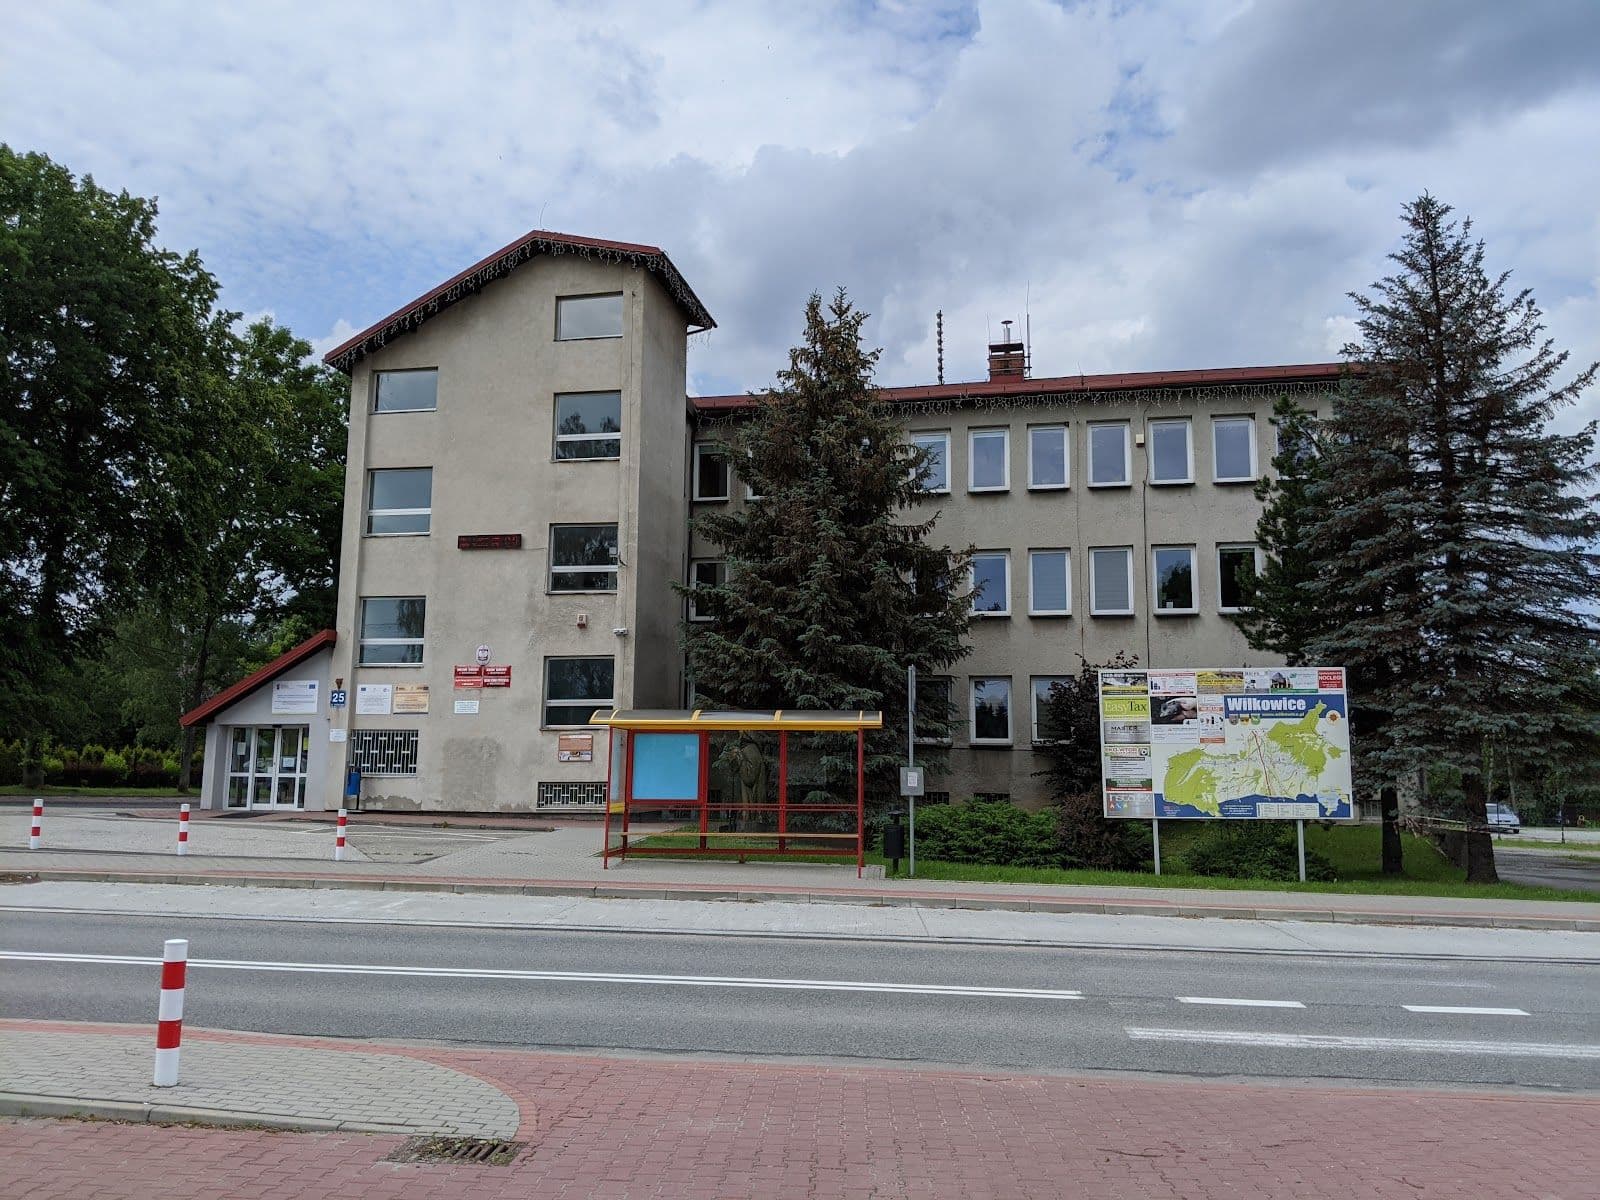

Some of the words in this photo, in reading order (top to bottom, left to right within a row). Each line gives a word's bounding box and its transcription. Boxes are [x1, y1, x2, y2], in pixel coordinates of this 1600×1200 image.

[332, 692, 344, 703] 25
[1227, 697, 1307, 711] Wilkowice
[1105, 701, 1147, 714] EasyTax
